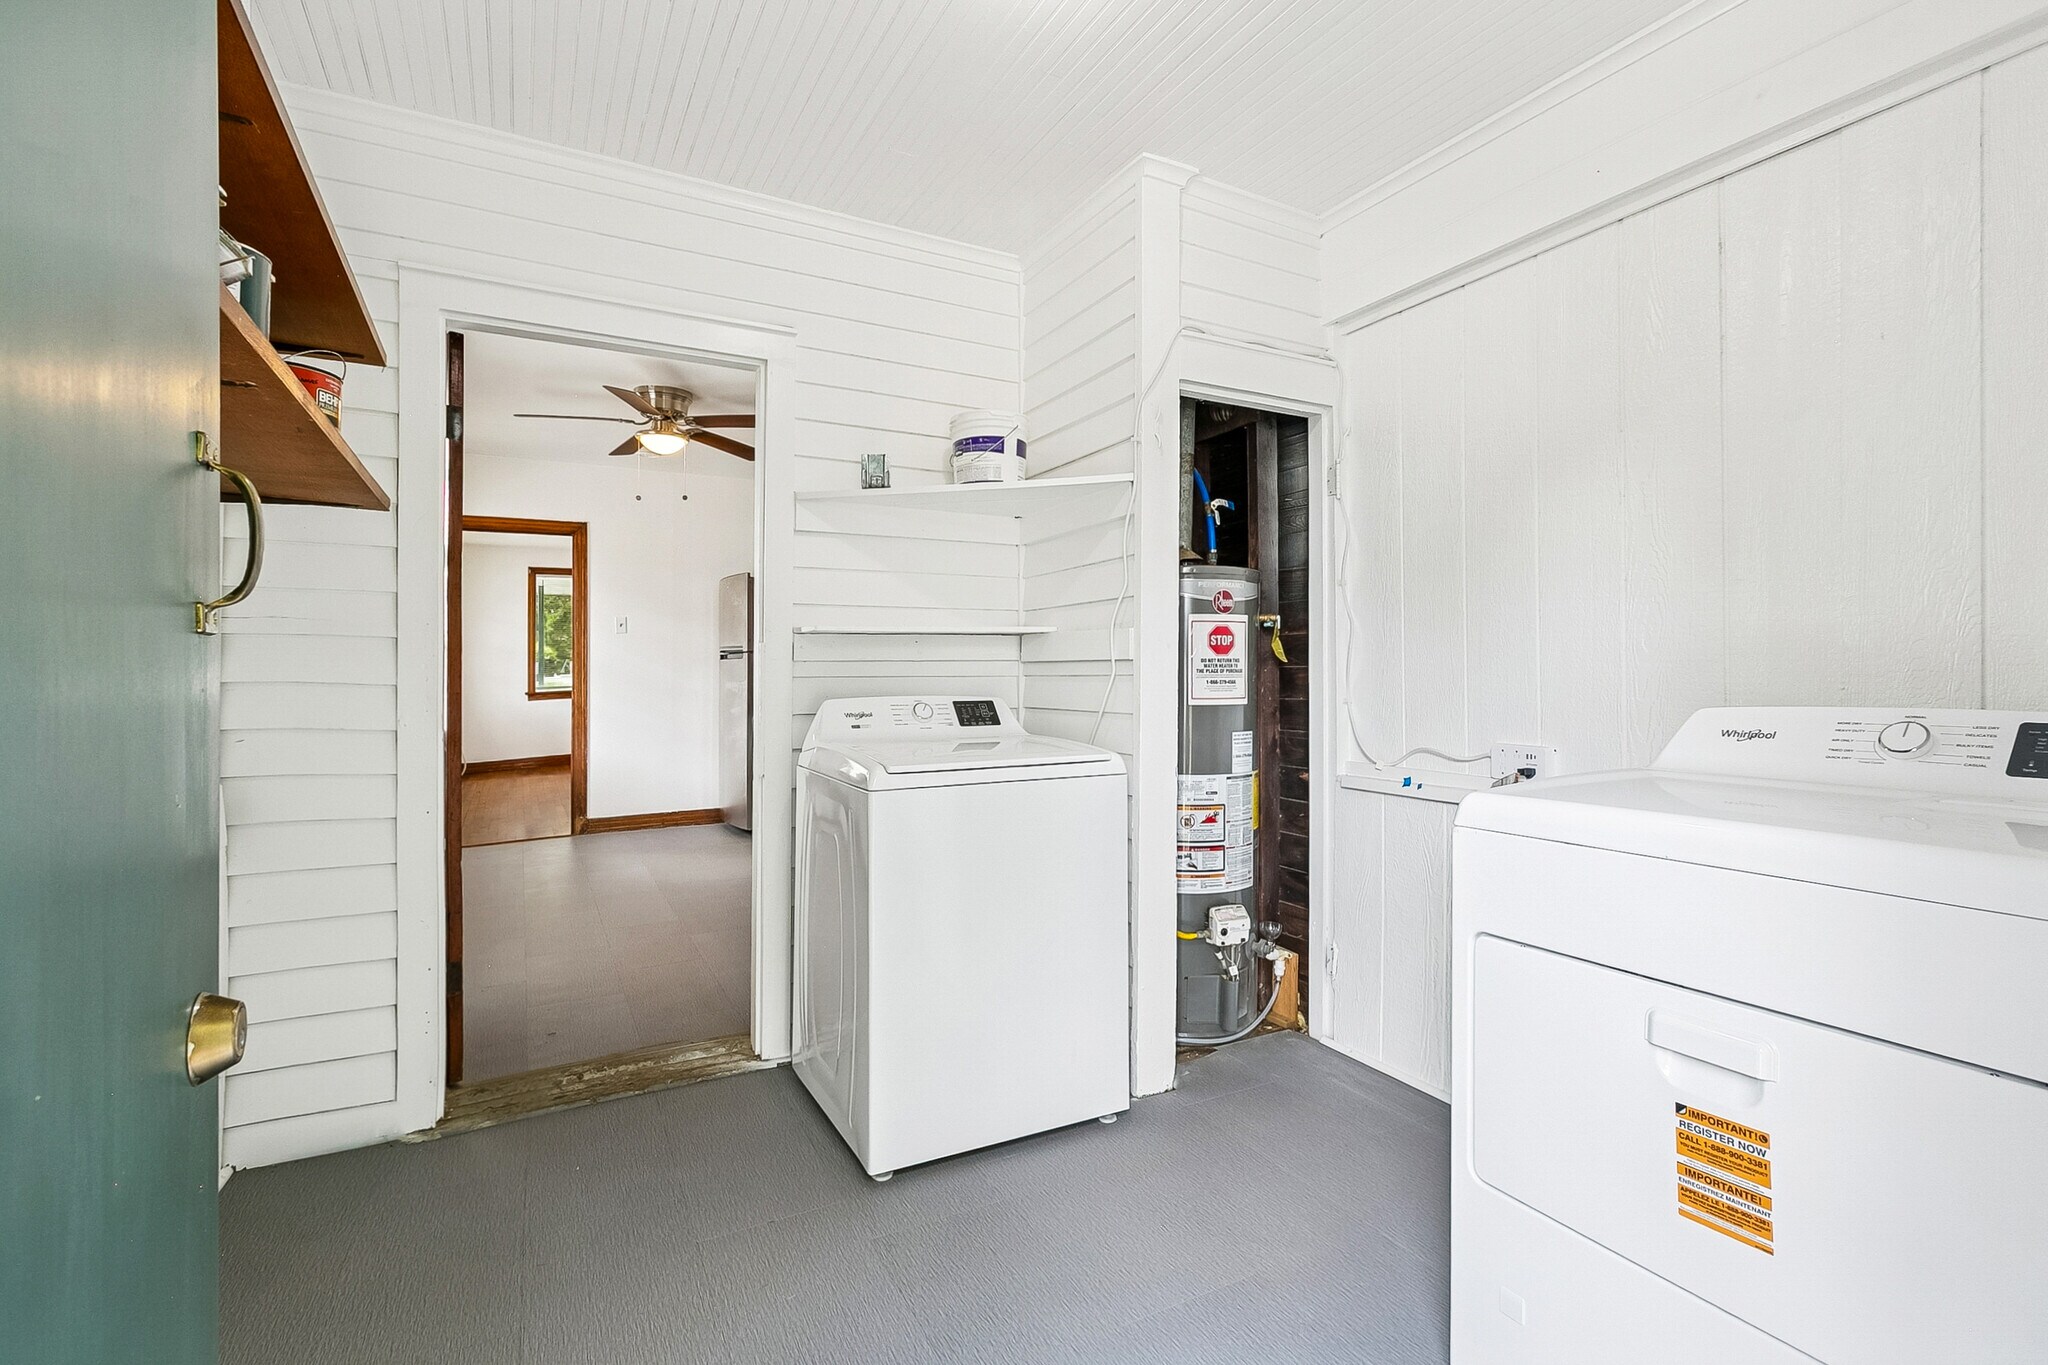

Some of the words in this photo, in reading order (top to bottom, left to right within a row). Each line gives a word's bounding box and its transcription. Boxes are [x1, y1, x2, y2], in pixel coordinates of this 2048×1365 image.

[1210, 635, 1233, 645] STOP
[844, 711, 872, 720] Whirlpool
[1721, 729, 1776, 742] Whirlpool
[1678, 1119, 1734, 1147] REGISTER
[1737, 1140, 1767, 1159] NOW
[1687, 1109, 1757, 1141] IMPORTANT!
[1678, 1131, 1701, 1146] CALL
[1703, 1140, 1767, 1171] 1-888-900-3381
[1689, 1144, 1703, 1153] MUST
[1703, 1150, 1727, 1162] REGISTER
[1728, 1159, 1742, 1168] YOUR
[1743, 1164, 1768, 1178] PRODUCT
[1678, 1175, 1724, 1200] ENREGISTREZ
[1724, 1194, 1771, 1219] MAINTENANT
[1684, 1166, 1762, 1206] IMPORTANTE!
[1680, 1185, 1709, 1202] APPELEZ
[1710, 1198, 1720, 1207] LE
[1721, 1203, 1770, 1228] 1-888-900-3381
